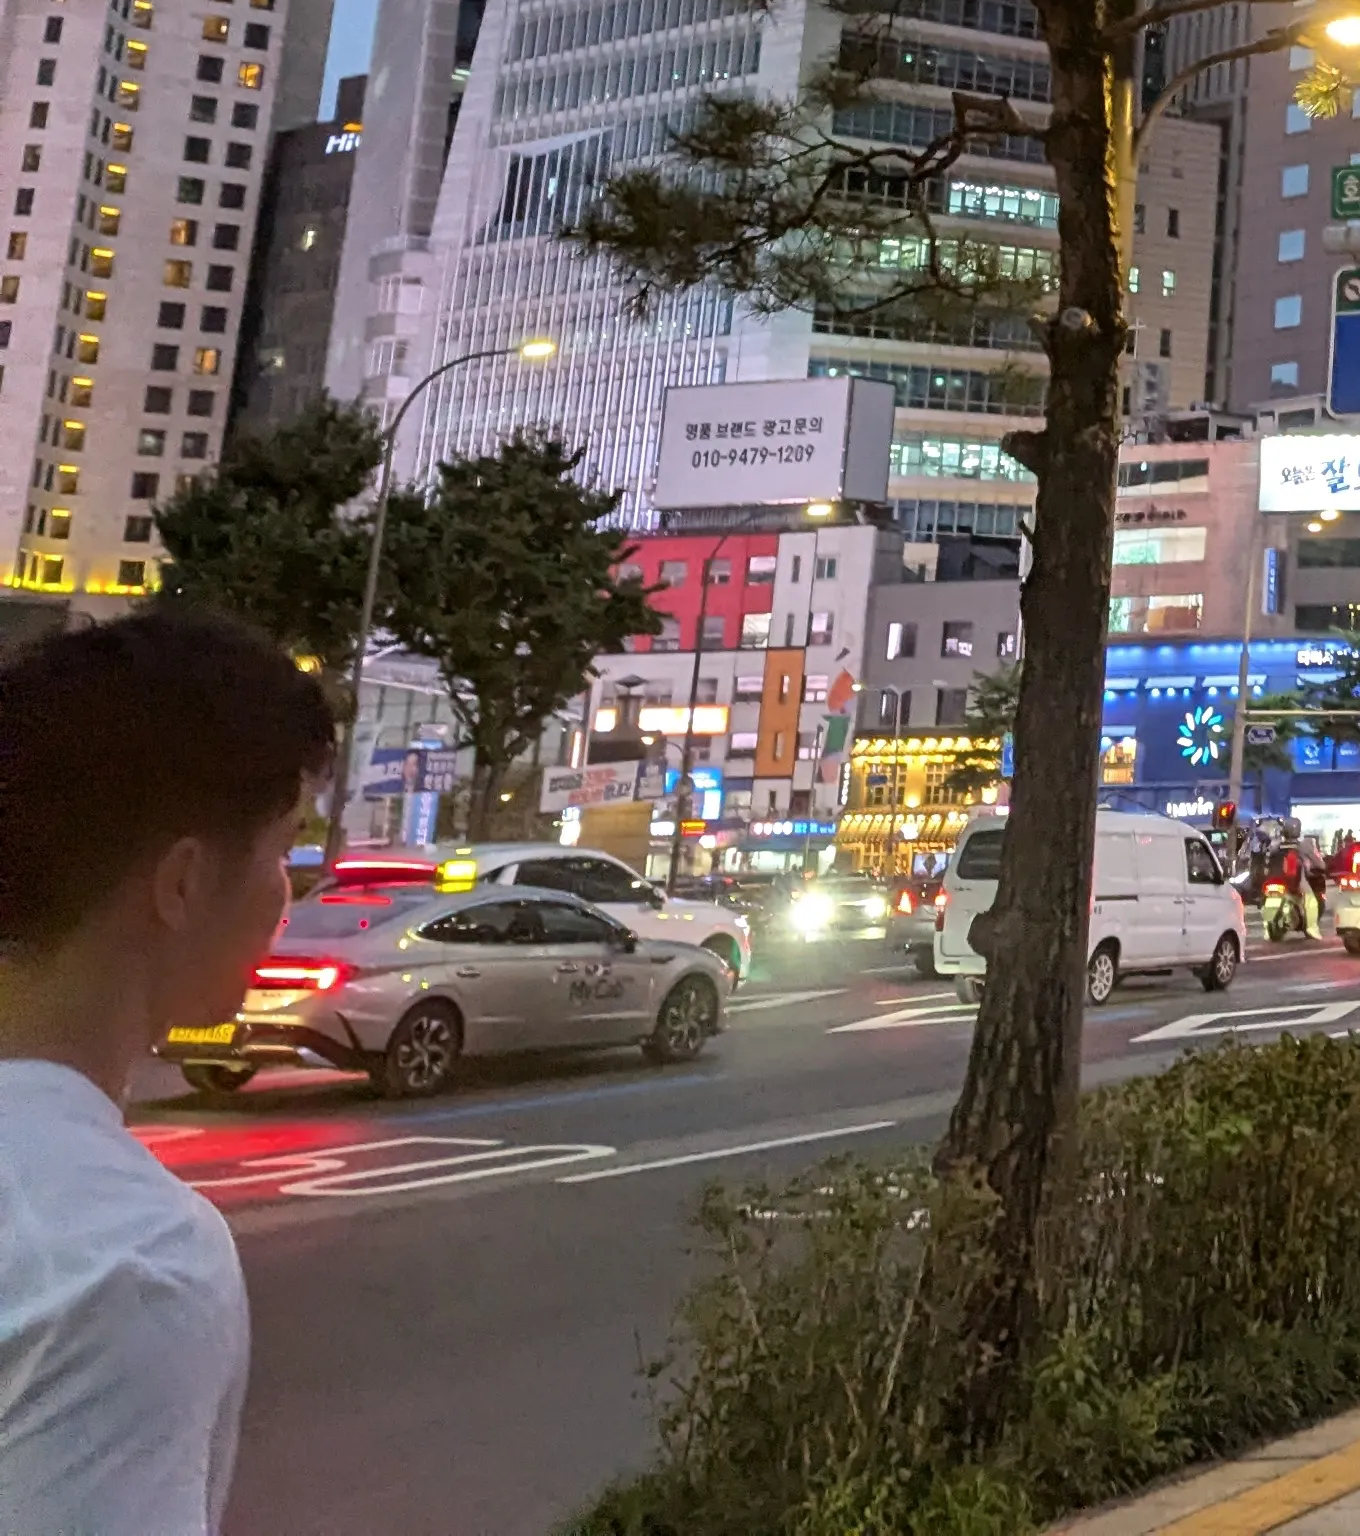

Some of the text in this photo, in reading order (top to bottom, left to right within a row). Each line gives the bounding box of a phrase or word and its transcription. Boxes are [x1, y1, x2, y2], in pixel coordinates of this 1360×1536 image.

[325, 132, 361, 154] Hi
[685, 421, 712, 441] 명품
[715, 420, 757, 439] 브랜드
[691, 443, 815, 468] 010-9479-1209
